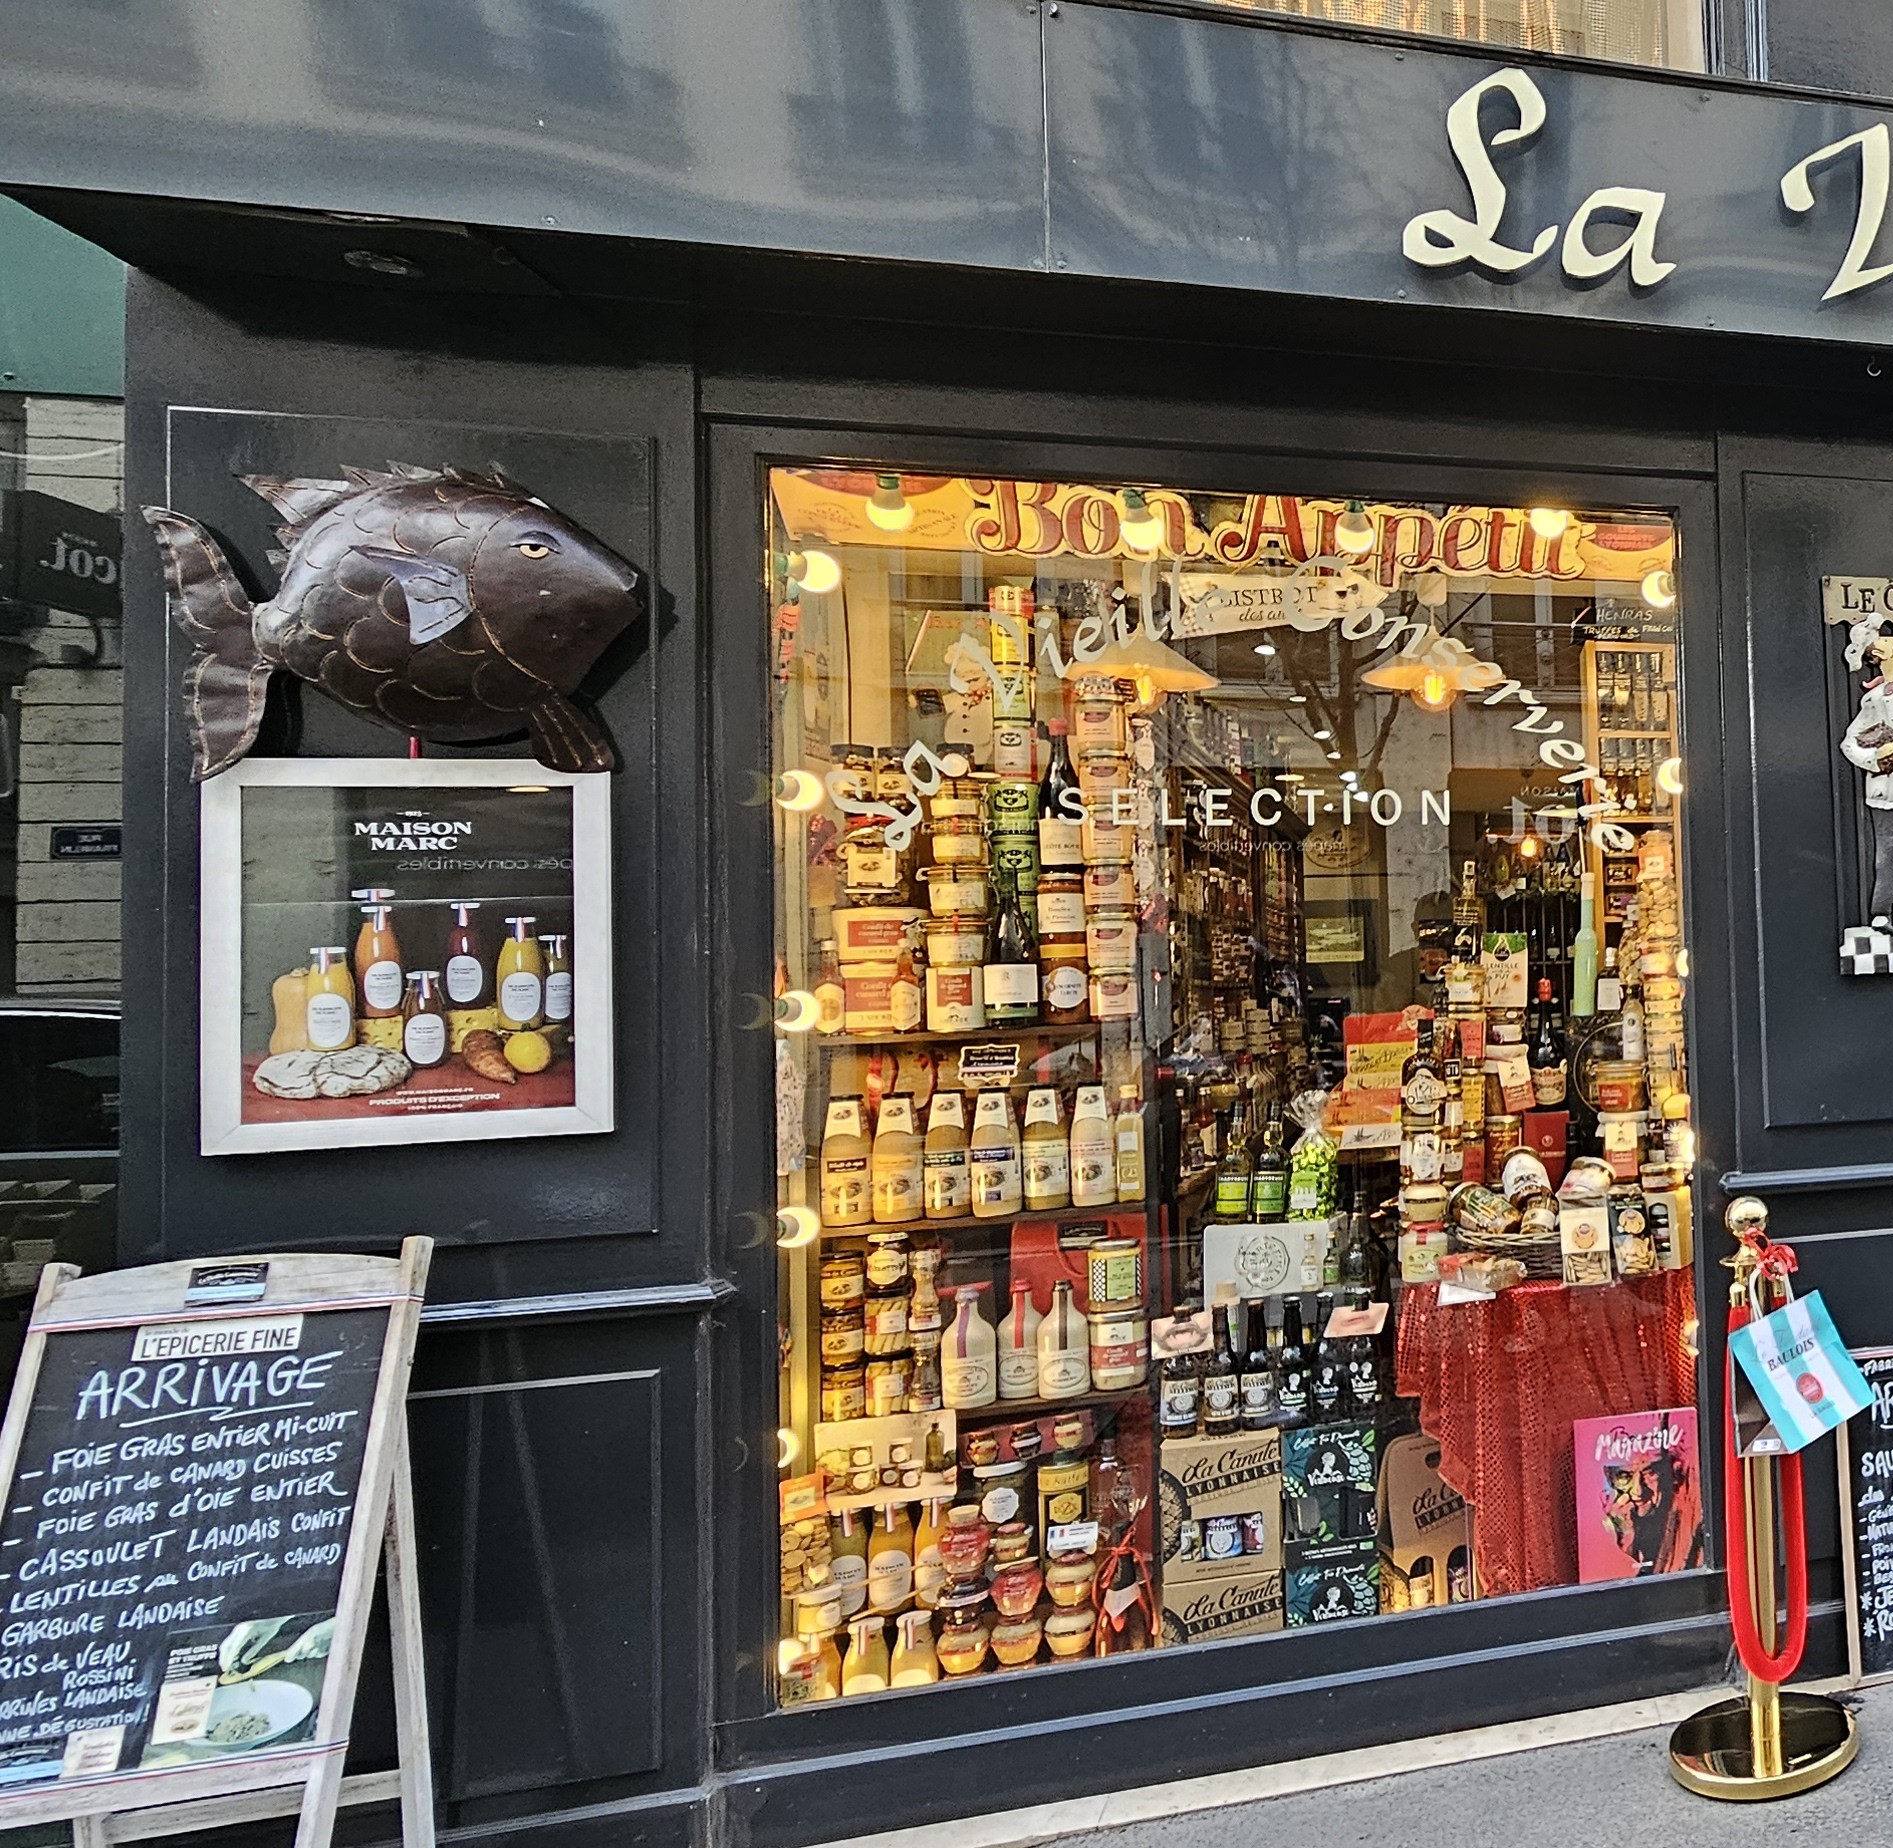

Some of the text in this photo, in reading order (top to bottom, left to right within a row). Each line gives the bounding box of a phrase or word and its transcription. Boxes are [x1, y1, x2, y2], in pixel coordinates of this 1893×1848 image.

[1402, 70, 1677, 286] La
[970, 480, 1204, 556] Bon
[1220, 585, 1318, 607] ISTRT
[1841, 583, 1876, 614] LE
[824, 554, 1637, 852] La Vieille Conserverie
[1058, 787, 1454, 826] SELECTION
[354, 821, 473, 836] MAISON
[371, 836, 458, 851] MARC
[368, 1092, 501, 1106] PRODUITS D'EXCEPTION
[140, 1326, 298, 1359] L'EPICERIE FINE
[1767, 1337, 1815, 1372] BAULOIS
[119, 1432, 186, 1462] GRAS
[1594, 1424, 1684, 1462] Magazine
[133, 1470, 162, 1491] de
[1182, 1457, 1217, 1484] La
[1185, 1462, 1282, 1498] LYONNAISE
[105, 1501, 159, 1529] GRAS
[1412, 1487, 1437, 1516] La
[19, 1529, 177, 1583] CASSOULET
[1183, 1597, 1217, 1624] La
[1185, 1598, 1283, 1635] LYONNAISE
[1, 1612, 106, 1647] GARBURE
[76, 1640, 131, 1670] VEAU
